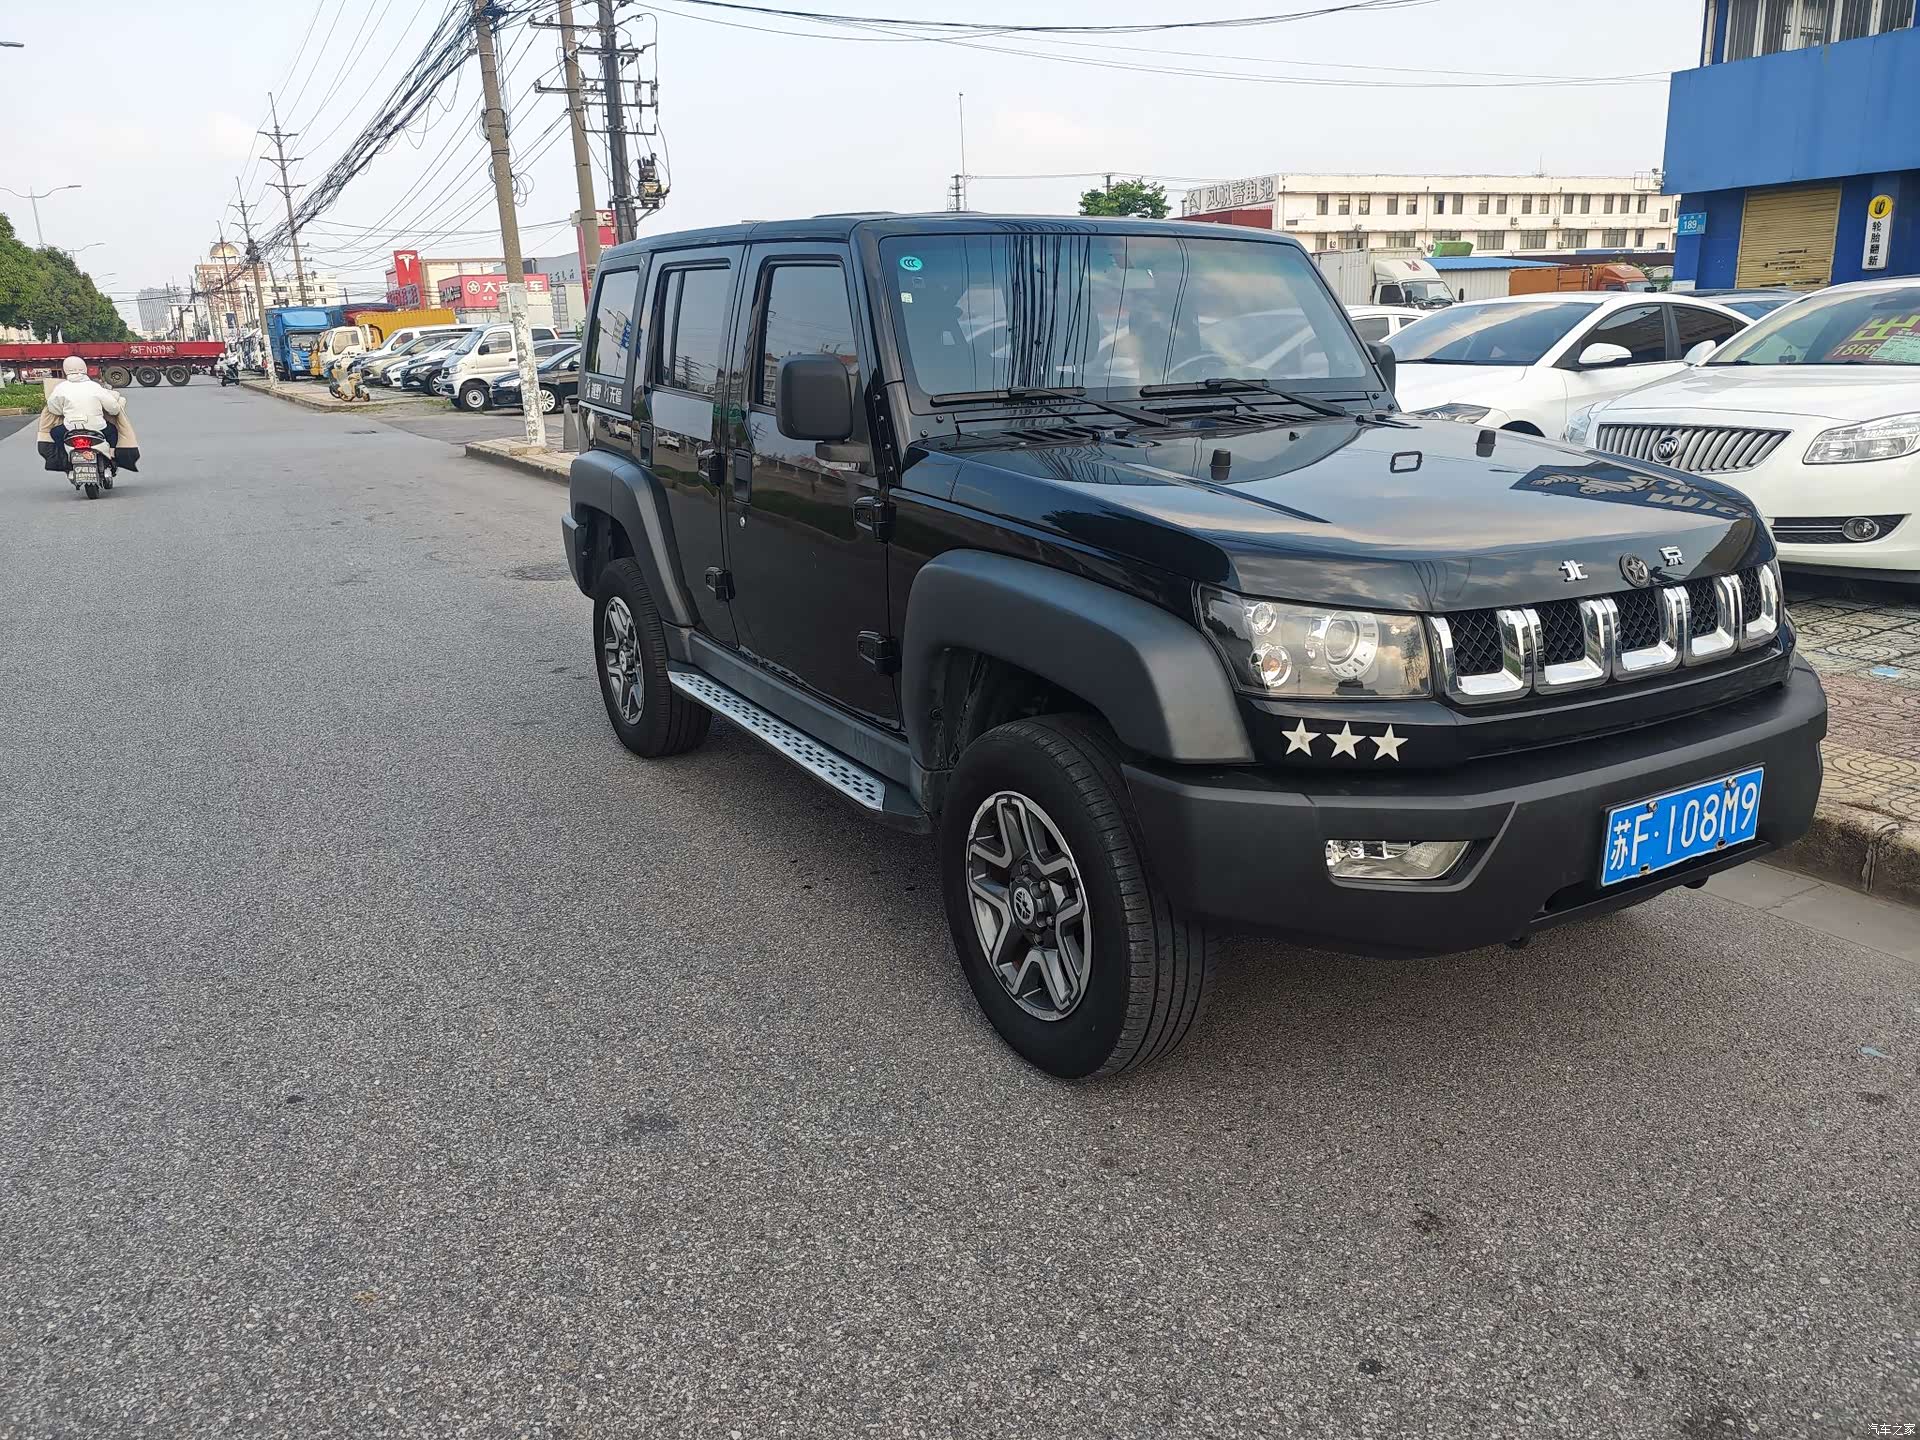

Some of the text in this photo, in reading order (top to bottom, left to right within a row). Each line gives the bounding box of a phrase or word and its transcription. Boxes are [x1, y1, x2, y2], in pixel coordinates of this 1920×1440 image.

[1206, 177, 1274, 208] 风帆蓄电池
[1683, 220, 1697, 230] 189
[1868, 221, 1882, 266] 轮胎翻新
[482, 280, 543, 293] 大运车
